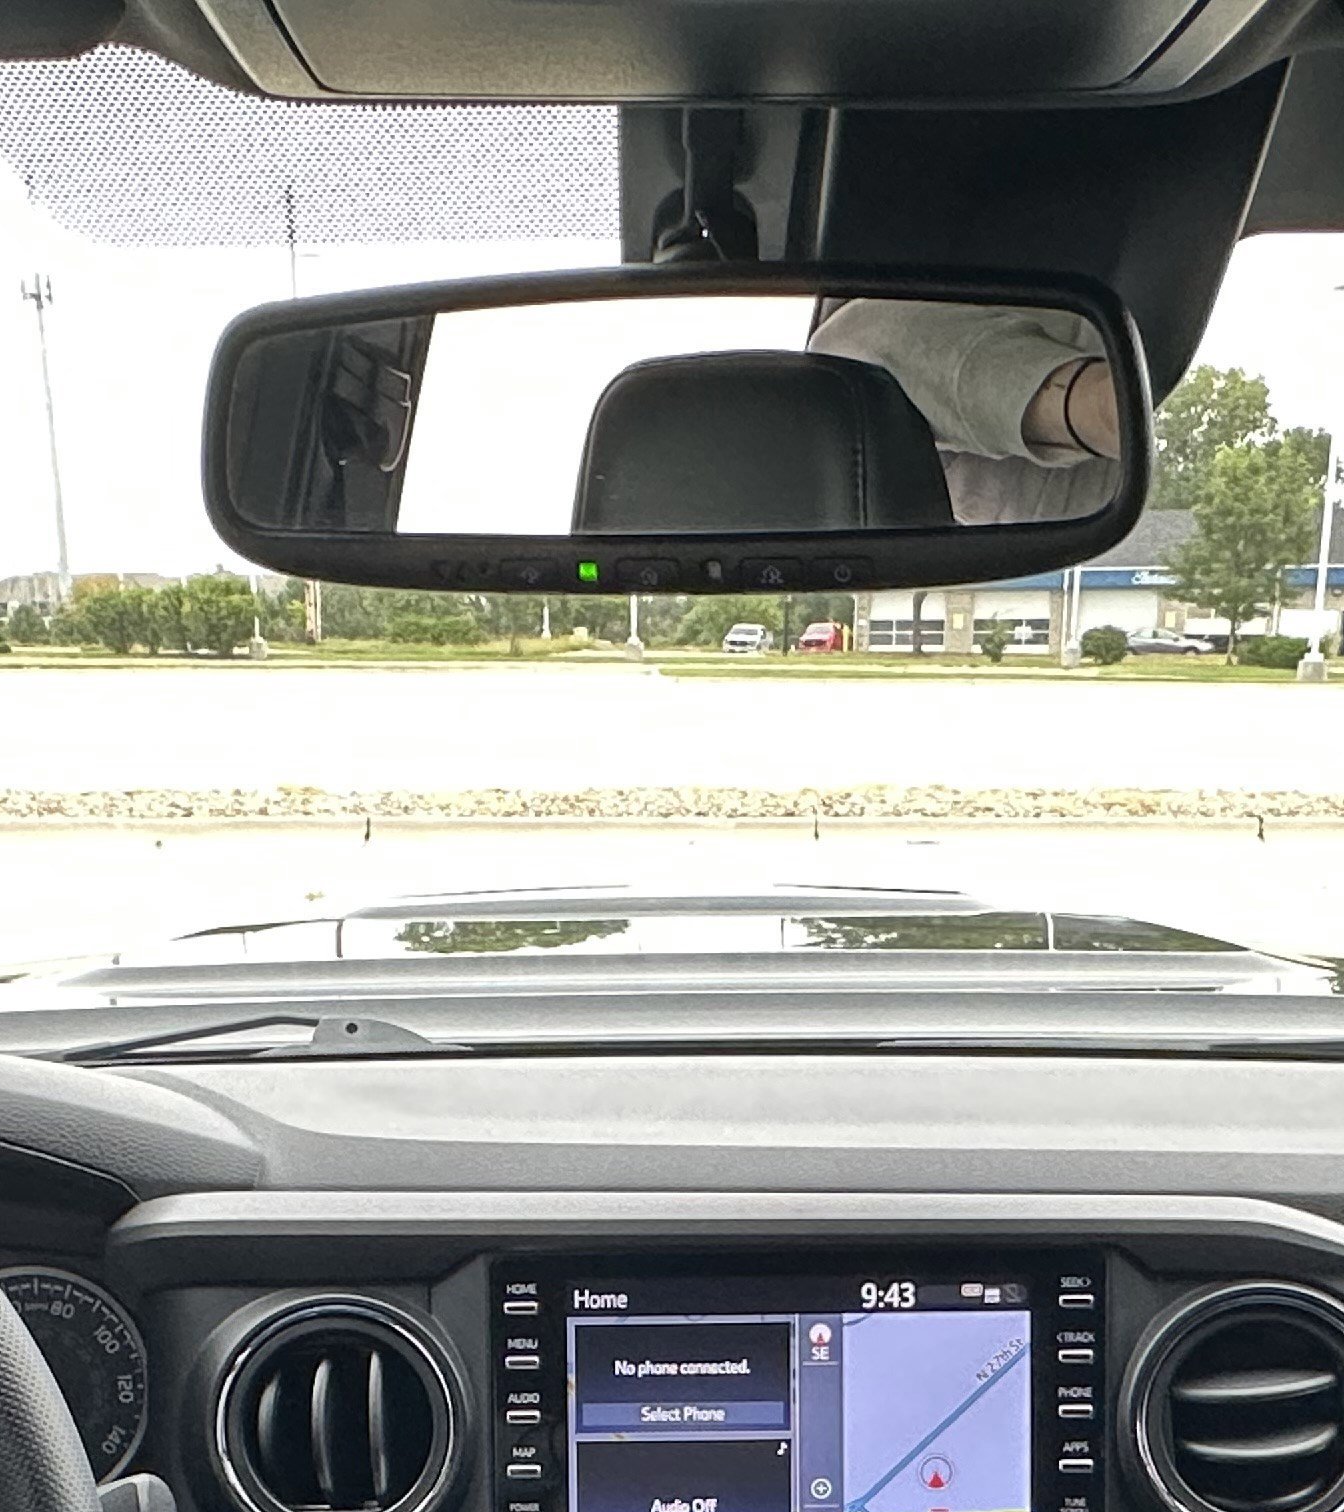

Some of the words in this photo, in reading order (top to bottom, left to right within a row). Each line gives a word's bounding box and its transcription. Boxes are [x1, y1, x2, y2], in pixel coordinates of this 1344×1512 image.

[506, 1283, 537, 1295] HOME
[860, 1282, 916, 1309] 9:43
[573, 1289, 628, 1309] Home
[51, 1300, 75, 1319] 80
[94, 1325, 120, 1354] 100
[507, 1338, 538, 1350] MENU
[811, 1346, 830, 1360] SE
[986, 1349, 1013, 1373] 27th
[613, 1360, 635, 1376] No
[637, 1360, 678, 1378] phone
[679, 1358, 751, 1375] connected.
[117, 1375, 134, 1403] 120
[1058, 1386, 1093, 1398] PHONE
[507, 1392, 540, 1404] AUDIO
[640, 1406, 681, 1422] Select
[683, 1406, 726, 1422] Phone
[512, 1446, 536, 1458] MAP
